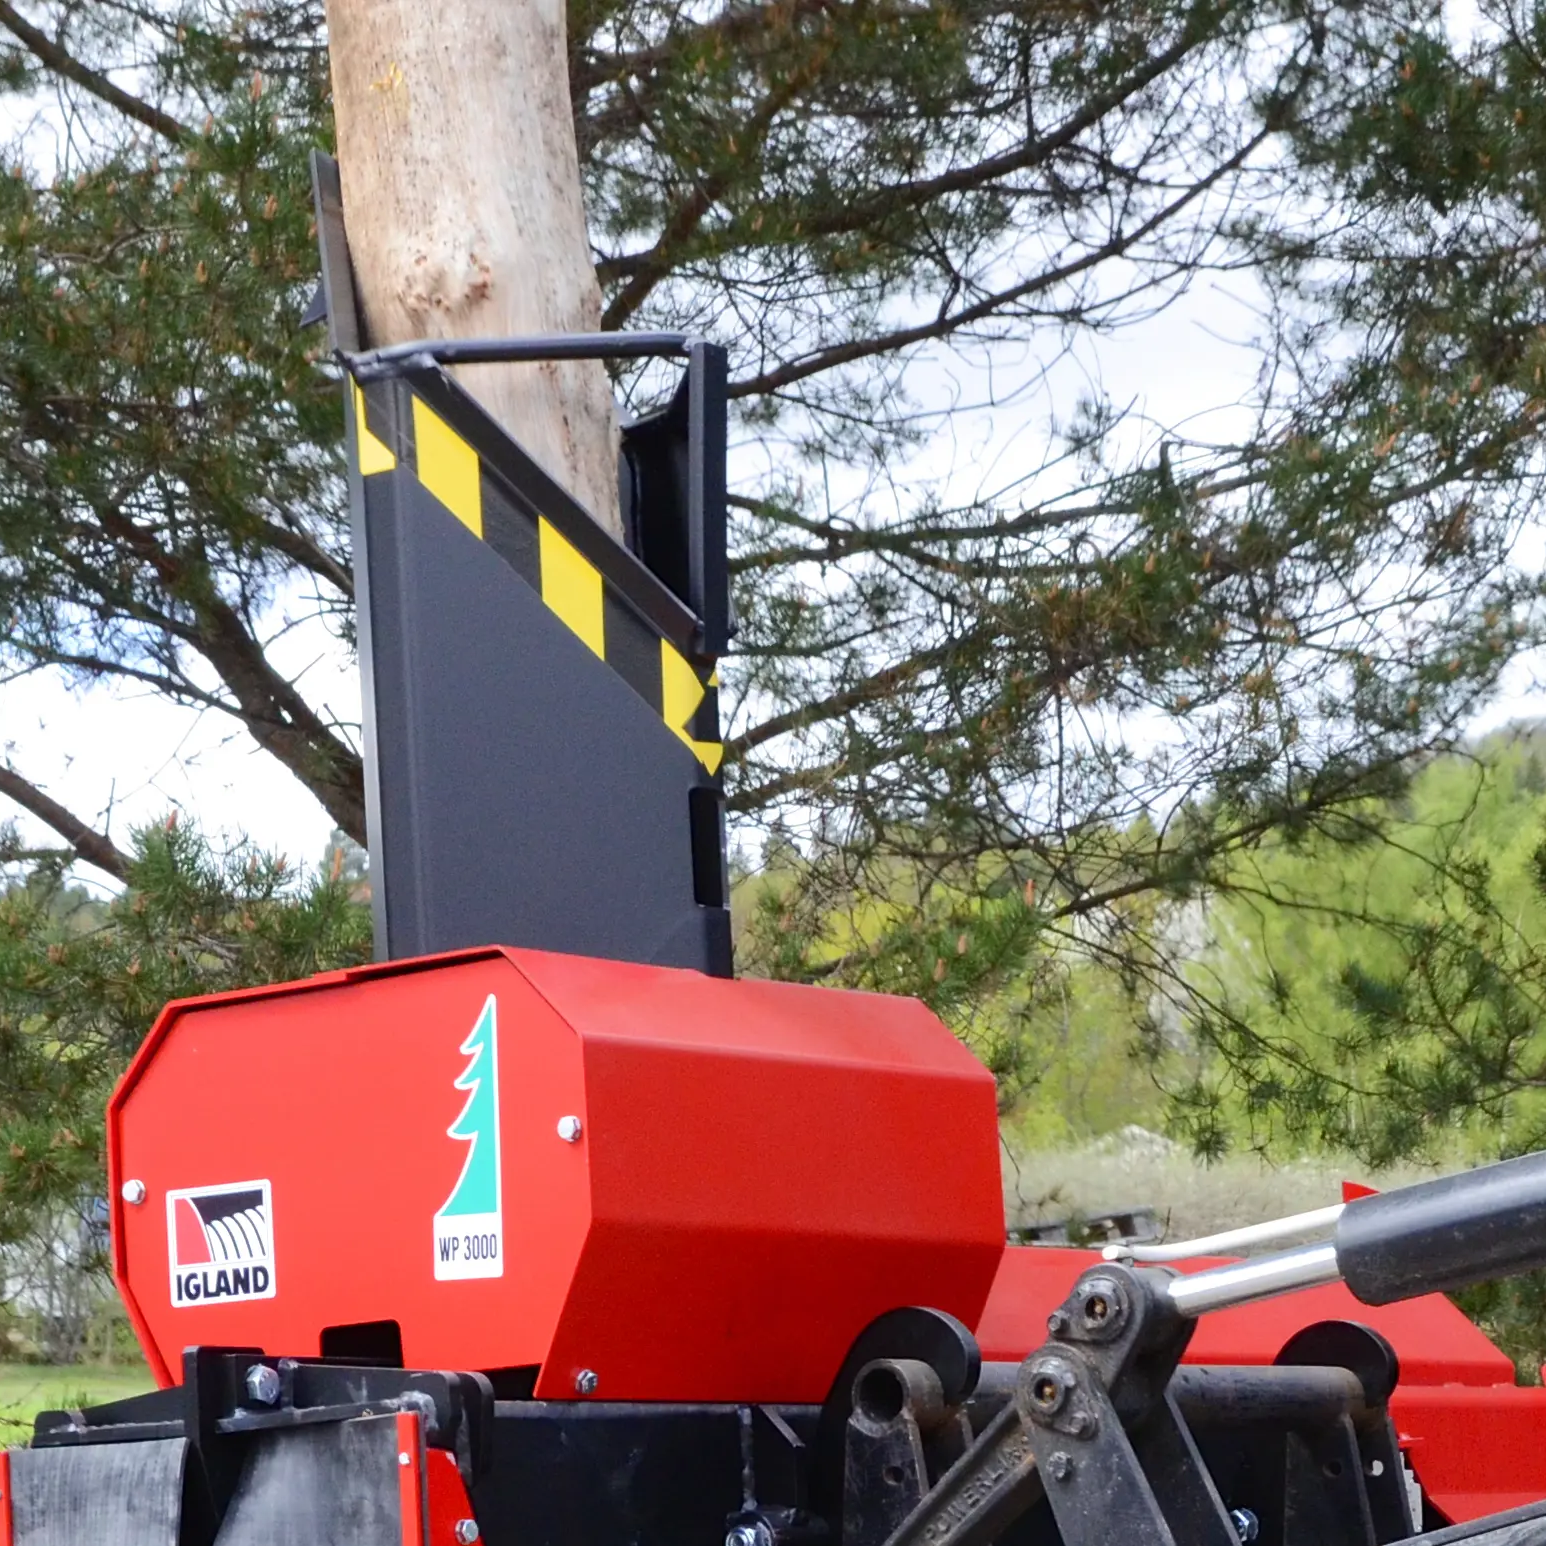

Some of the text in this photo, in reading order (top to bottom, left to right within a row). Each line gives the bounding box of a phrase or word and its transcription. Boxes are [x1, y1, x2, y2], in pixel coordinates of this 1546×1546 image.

[439, 1234, 498, 1262] WP 3000
[176, 1265, 270, 1301] IGLAND
